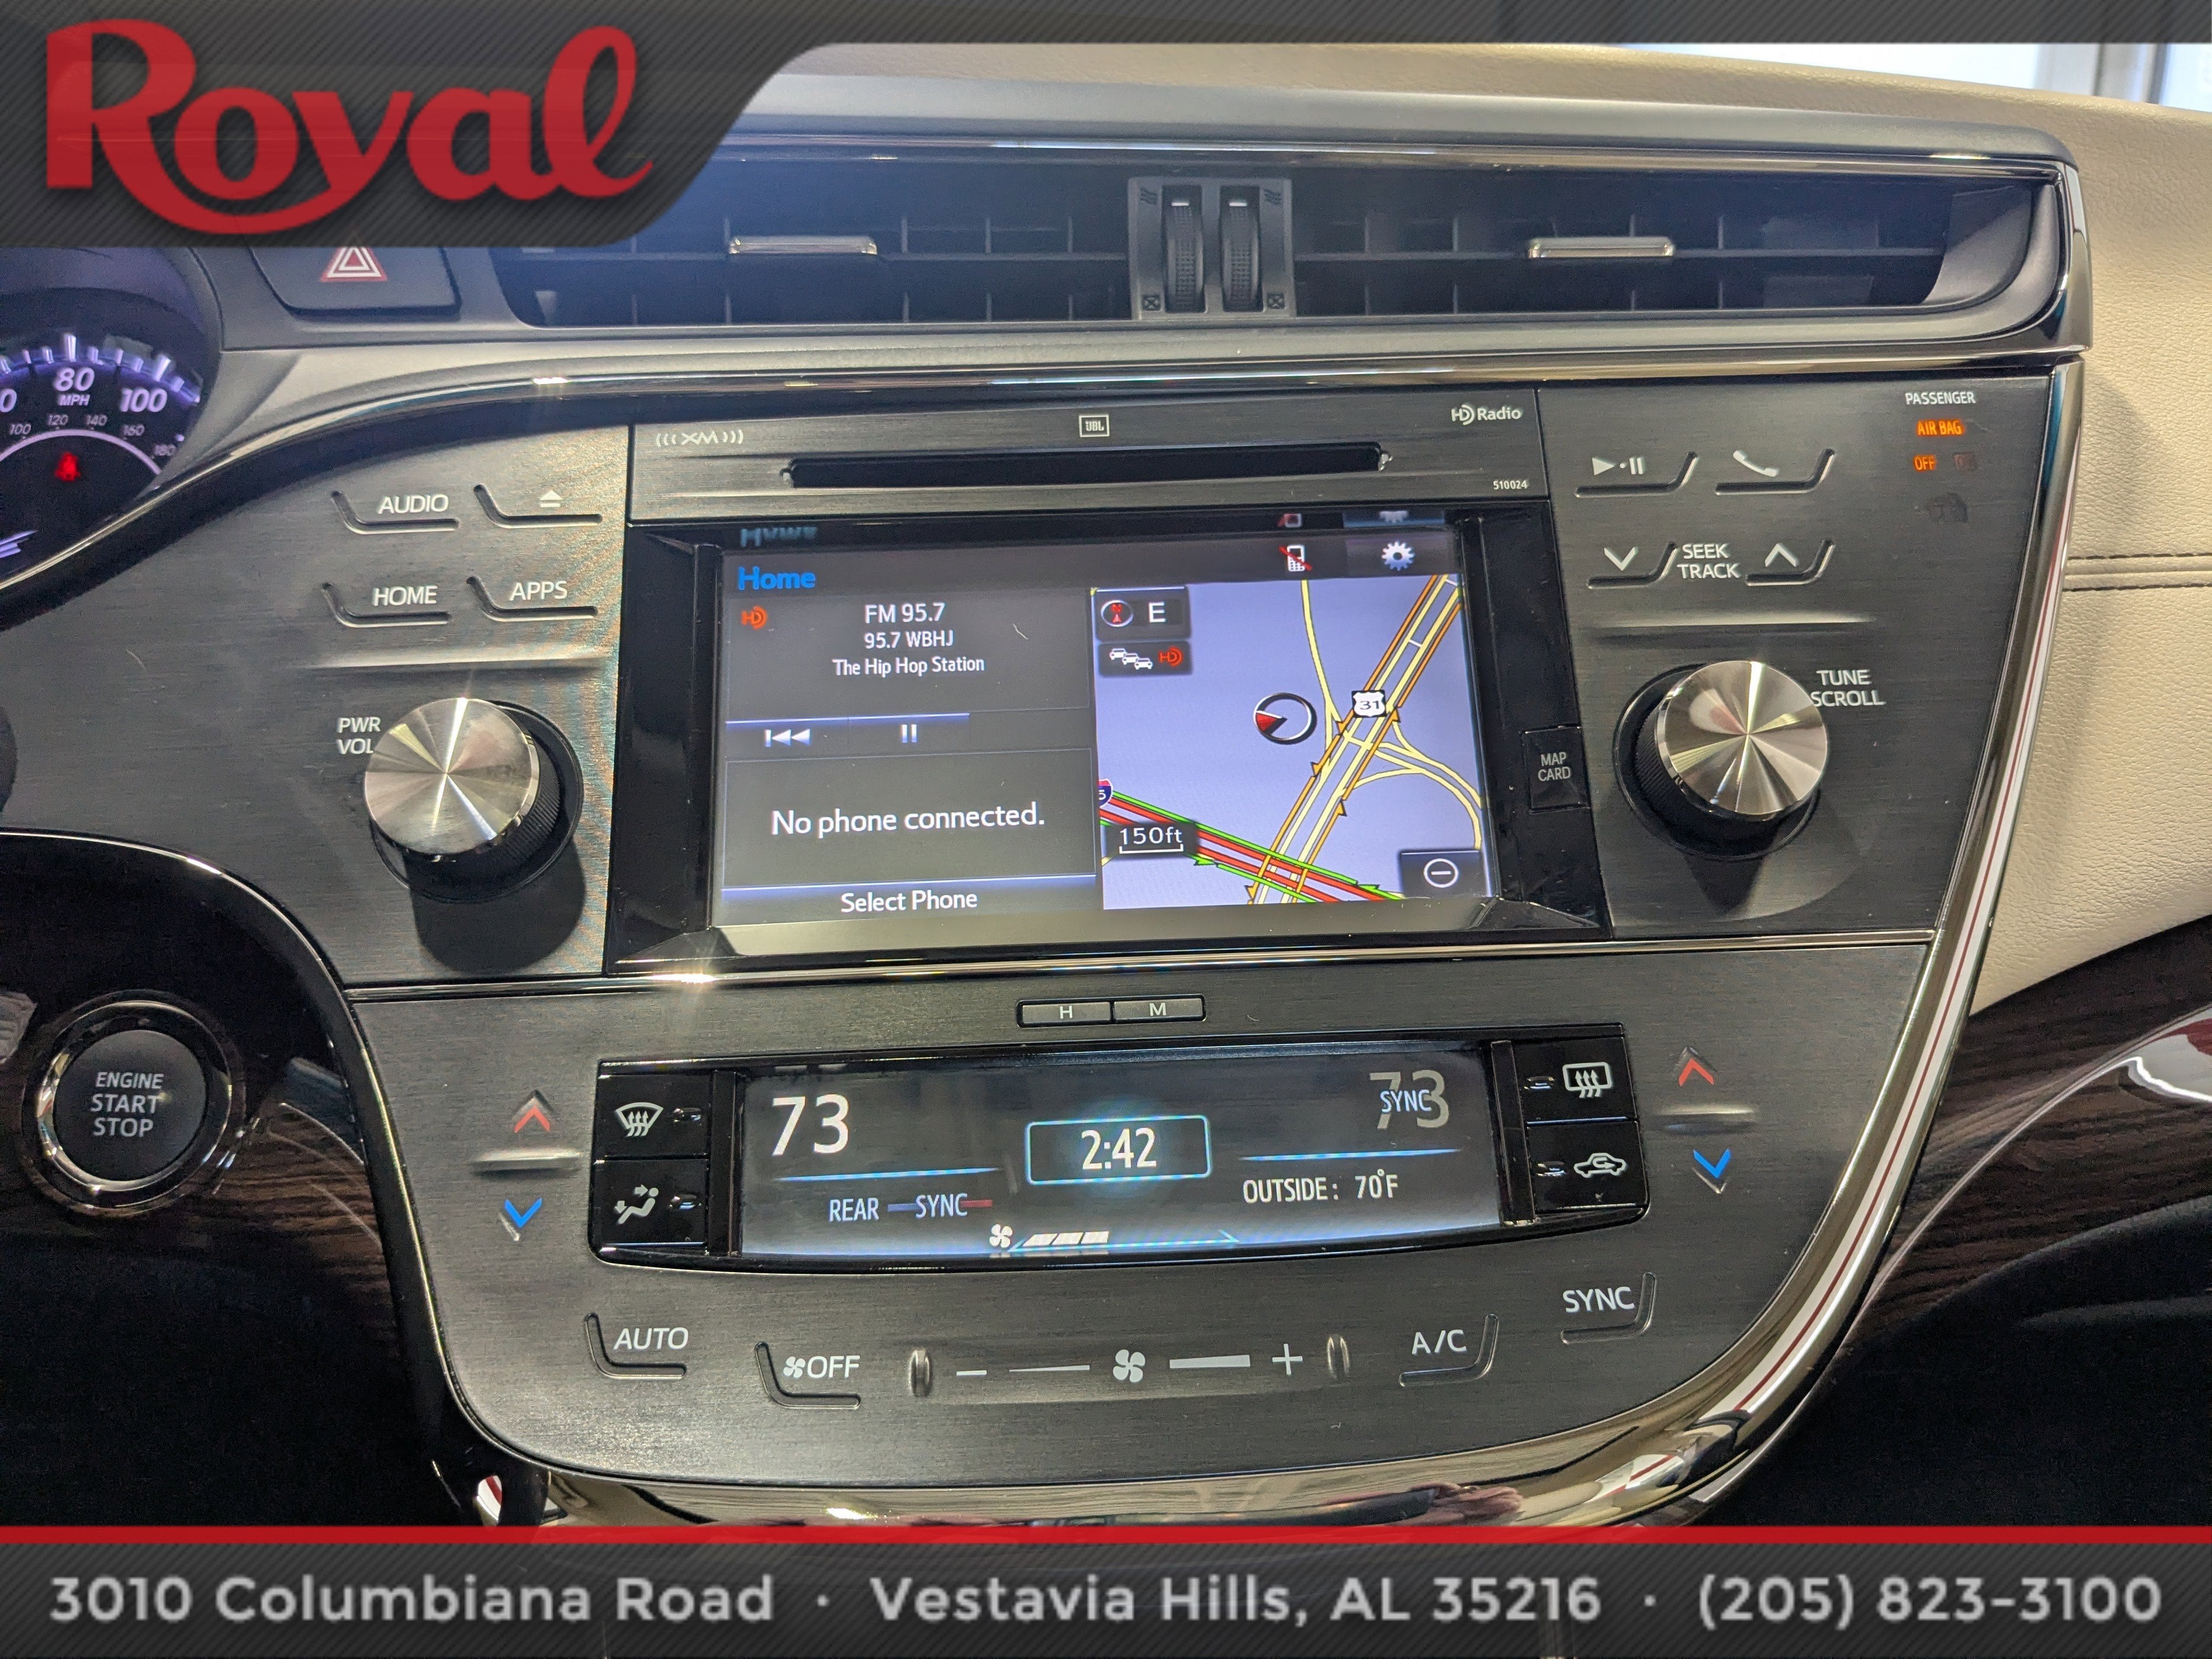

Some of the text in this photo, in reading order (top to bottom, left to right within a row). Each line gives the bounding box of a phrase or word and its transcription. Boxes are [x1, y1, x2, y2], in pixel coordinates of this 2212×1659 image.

[55, 367, 95, 392] 80
[0, 387, 17, 413] 0
[59, 394, 91, 407] MPH
[120, 388, 168, 413] 100
[1905, 391, 1976, 406] PASSENGER
[48, 414, 69, 426] 120
[86, 414, 108, 426] 140
[1476, 406, 1522, 421] Radio
[10, 424, 32, 436] 100
[1085, 420, 1105, 432] JBL
[1917, 420, 1963, 436] AIR BAG
[1914, 455, 1937, 471] OFF
[1493, 479, 1528, 490] 510024
[377, 494, 449, 514] AUDIO
[1681, 543, 1730, 560] SEEK
[738, 566, 816, 591] Home
[1677, 563, 1740, 579] TRACK
[372, 586, 438, 607] HOME
[509, 581, 567, 601] APPS
[865, 603, 945, 623] FM 95.7
[1149, 602, 1166, 622] E
[864, 630, 954, 648] 95.7 WBHJ
[833, 657, 985, 677] The Hip Hop Station
[1816, 669, 1871, 686] TUNE
[1359, 699, 1383, 710] 31
[1810, 689, 1885, 706] SCROLL
[337, 717, 381, 733] PWR
[338, 738, 374, 754] VOL
[1541, 752, 1567, 766] MAP
[1538, 767, 1571, 781] CARD
[771, 802, 1045, 838] No phone connected.
[1120, 826, 1182, 845] 150ft
[841, 890, 978, 912] Select Phone
[1059, 1006, 1073, 1019] H
[1149, 1002, 1167, 1017] M
[95, 1071, 164, 1089] ENGINE
[90, 1093, 159, 1114] START
[1380, 1089, 1431, 1113] SYNC
[93, 1118, 153, 1137] STOP
[772, 1094, 849, 1155] 73
[1081, 1128, 1156, 1170] 2:42
[1243, 1177, 1339, 1203] OUTSIDE:
[830, 1194, 968, 1221] REAR SYNC
[1562, 1286, 1634, 1312] SYNC
[614, 1328, 689, 1350] AUTO
[1412, 1330, 1466, 1354] A/C
[807, 1356, 860, 1378] OFF
